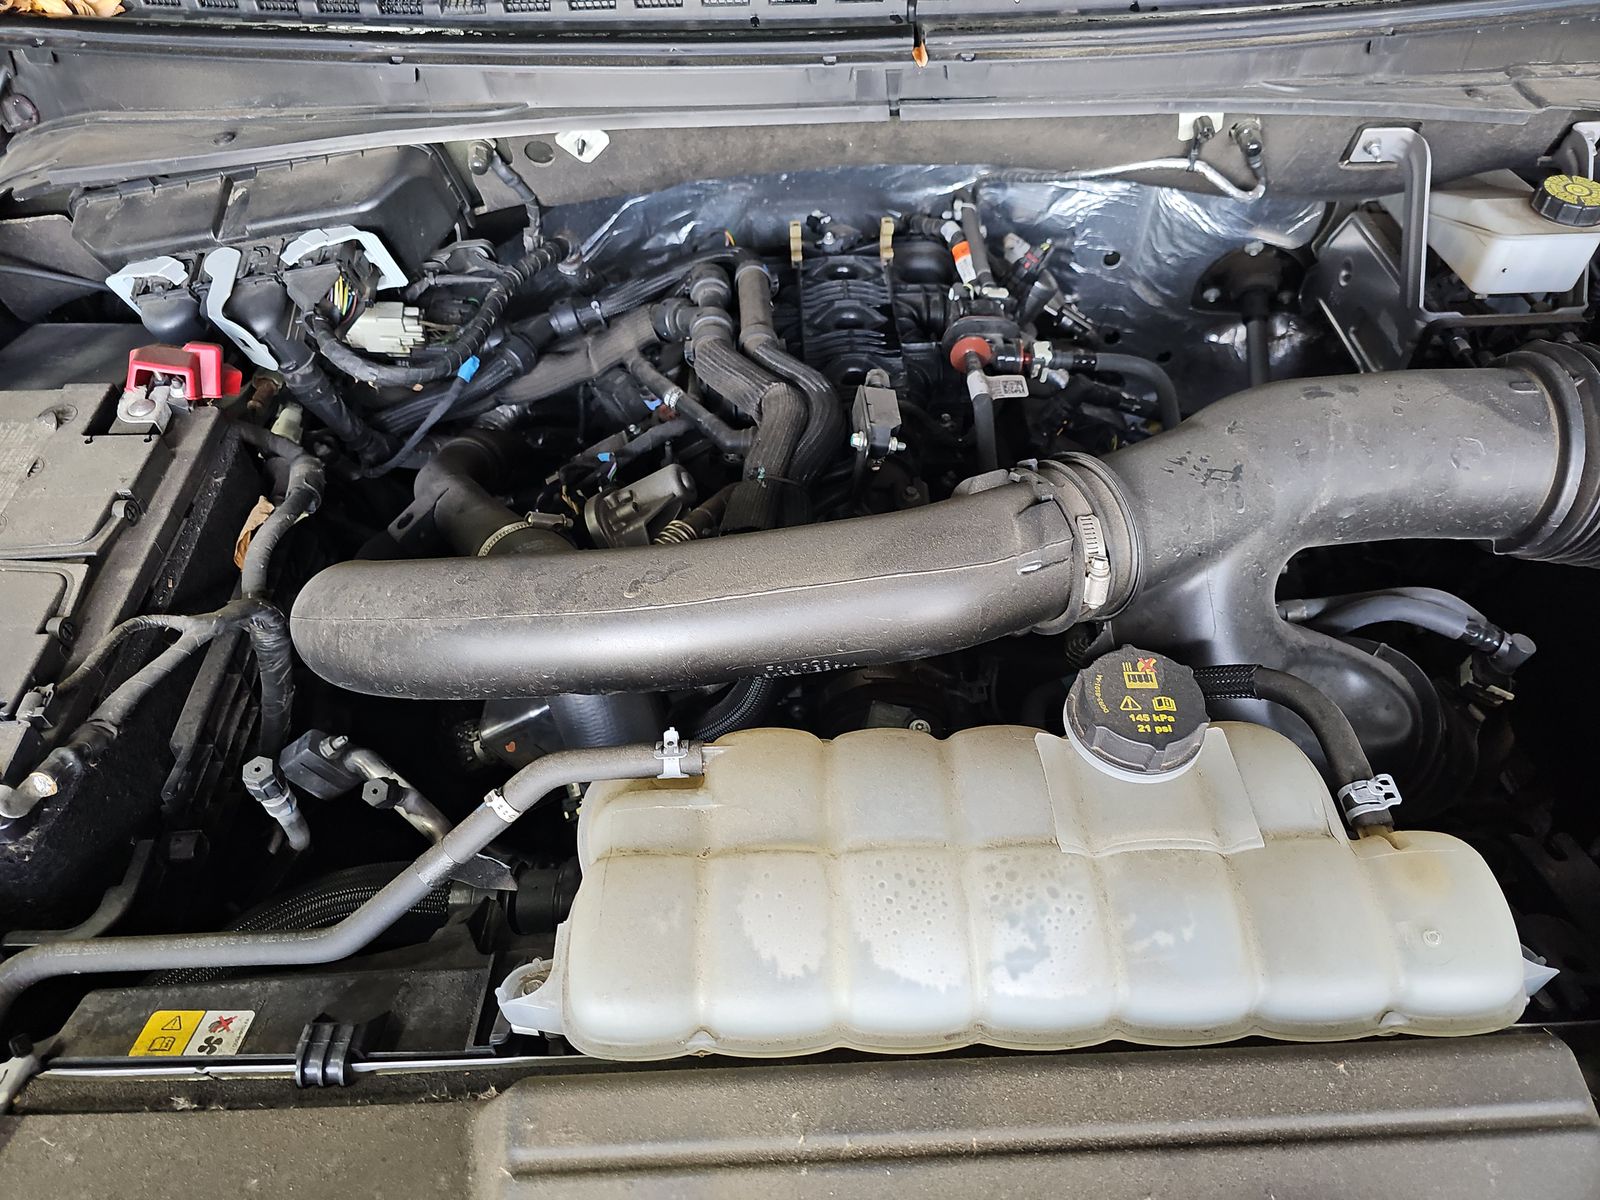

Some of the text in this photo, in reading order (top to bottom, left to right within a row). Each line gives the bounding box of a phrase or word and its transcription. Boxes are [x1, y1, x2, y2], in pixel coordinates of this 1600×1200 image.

[1129, 713, 1176, 722] 145 kPa
[1137, 724, 1173, 734] 21 psi
